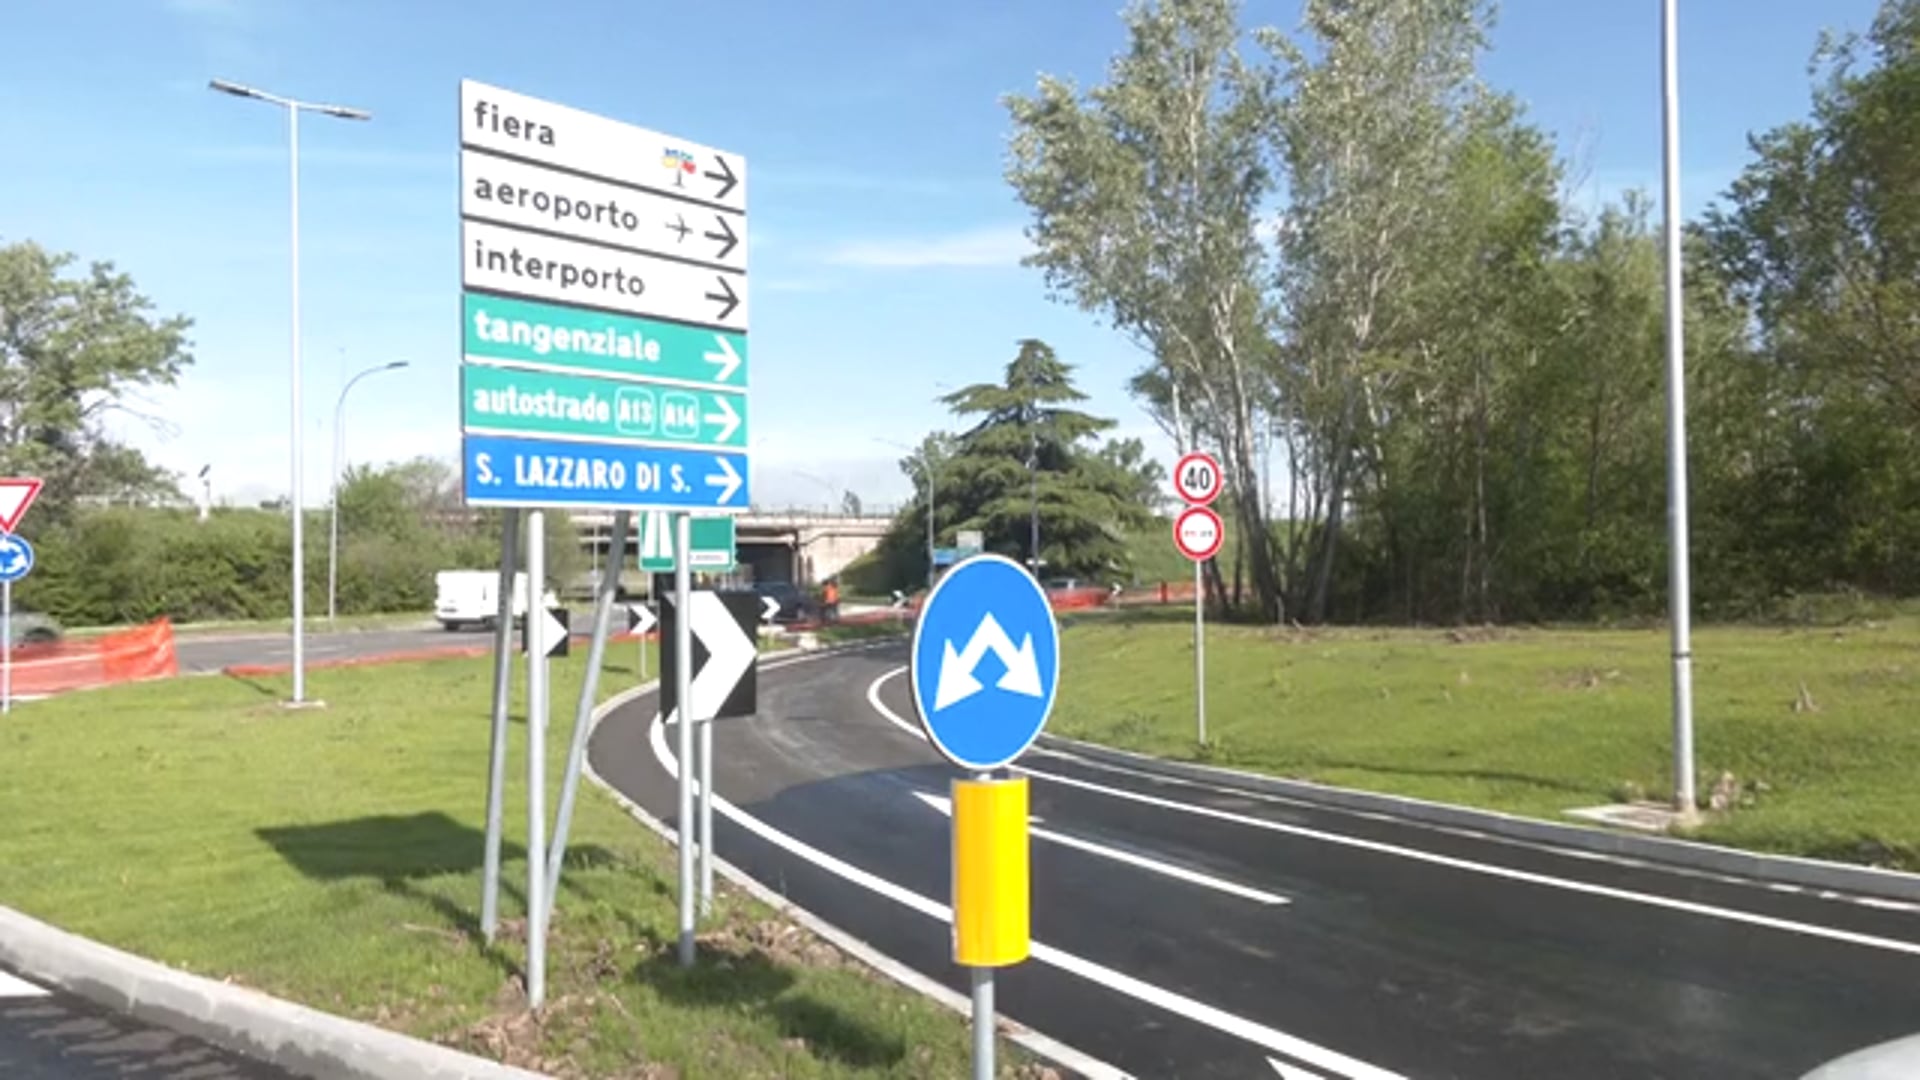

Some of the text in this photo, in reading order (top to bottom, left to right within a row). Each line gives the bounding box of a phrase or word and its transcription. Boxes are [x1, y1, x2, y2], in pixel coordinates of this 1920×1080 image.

[474, 100, 556, 147] fiera
[474, 178, 639, 231] aeroporto
[475, 240, 645, 297] interporto
[474, 309, 661, 362] tangenziale
[473, 386, 696, 428] autostrade A13 A14
[475, 453, 692, 493] S. LAZZARO DI S.
[1184, 467, 1210, 490] 40
